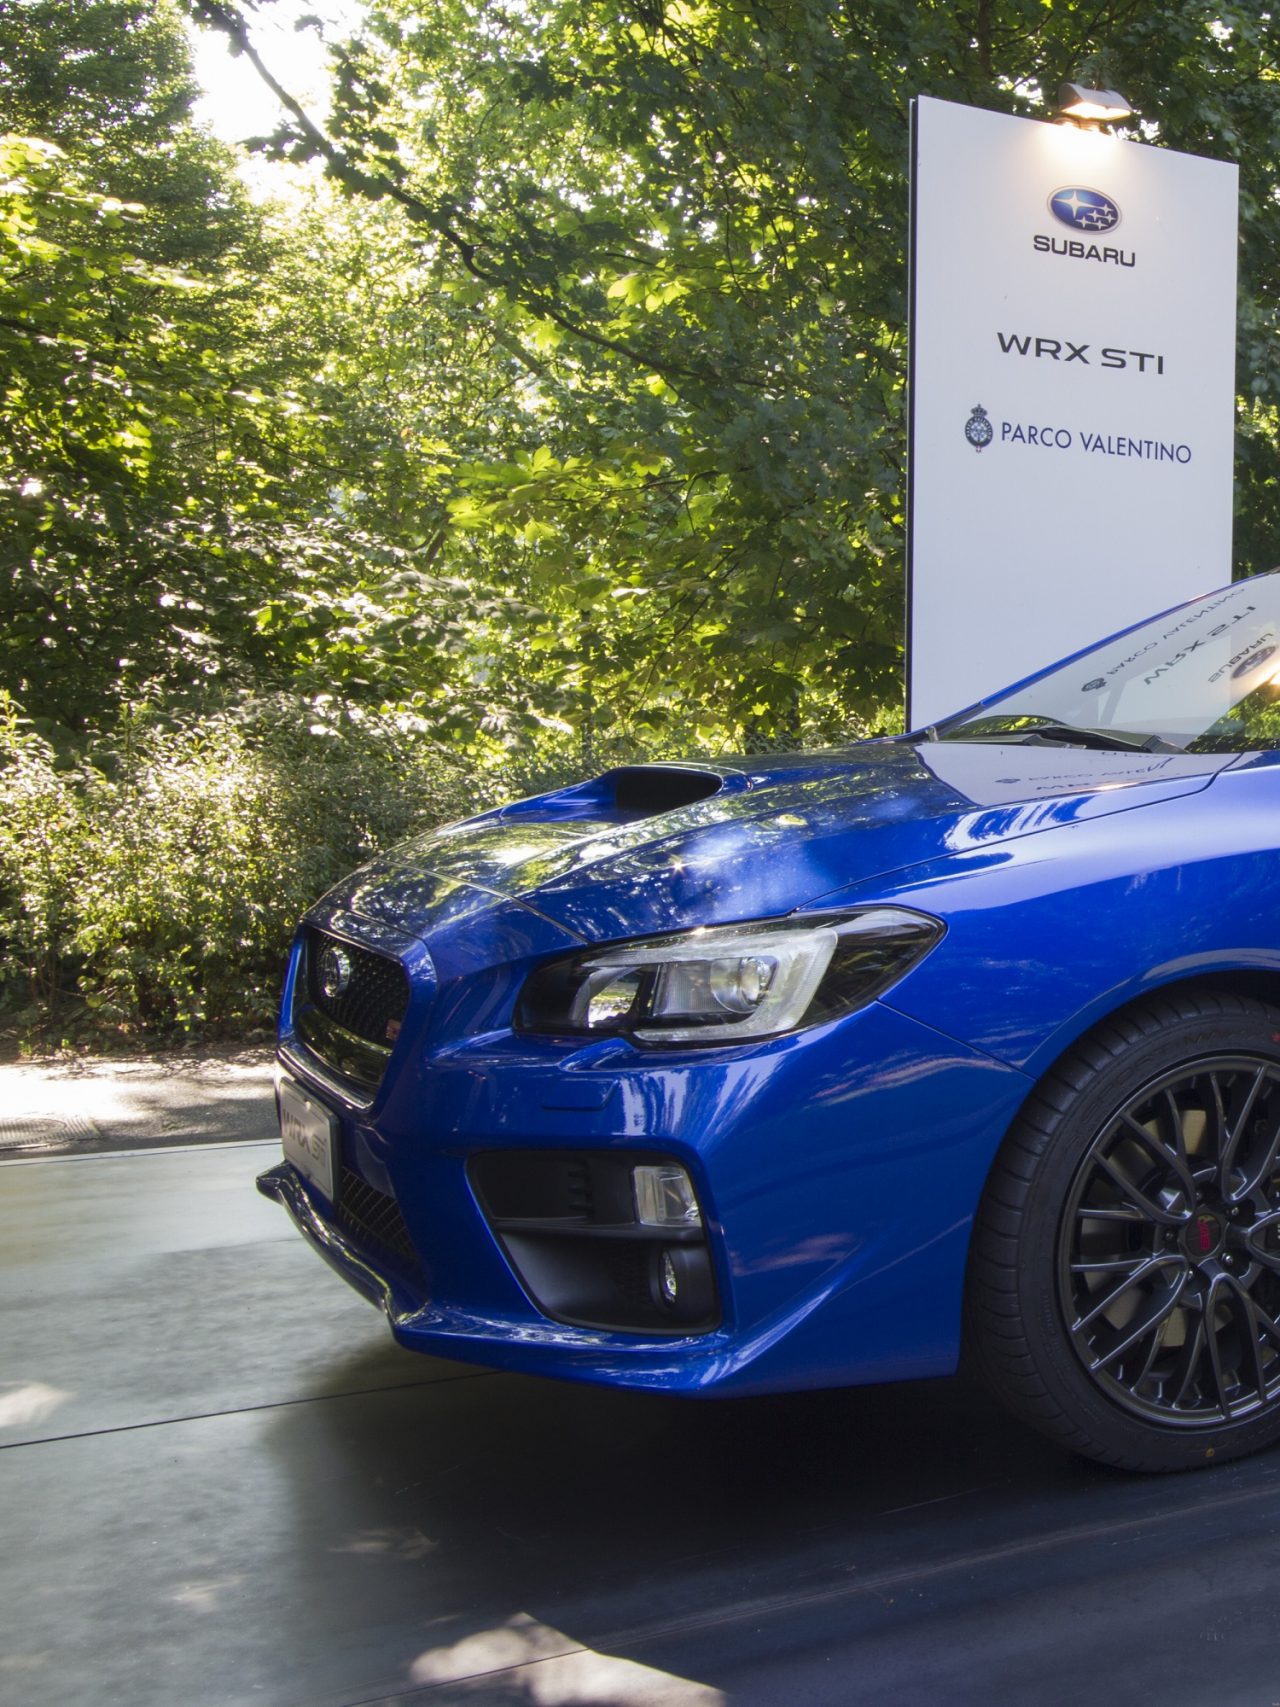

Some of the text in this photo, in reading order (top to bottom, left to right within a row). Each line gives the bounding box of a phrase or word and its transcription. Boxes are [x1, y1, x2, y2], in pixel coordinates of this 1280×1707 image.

[1033, 234, 1136, 267] SUBARU
[996, 332, 1164, 375] WRX STI
[1001, 421, 1072, 450] PARCO
[1080, 431, 1192, 465] VALENTINO
